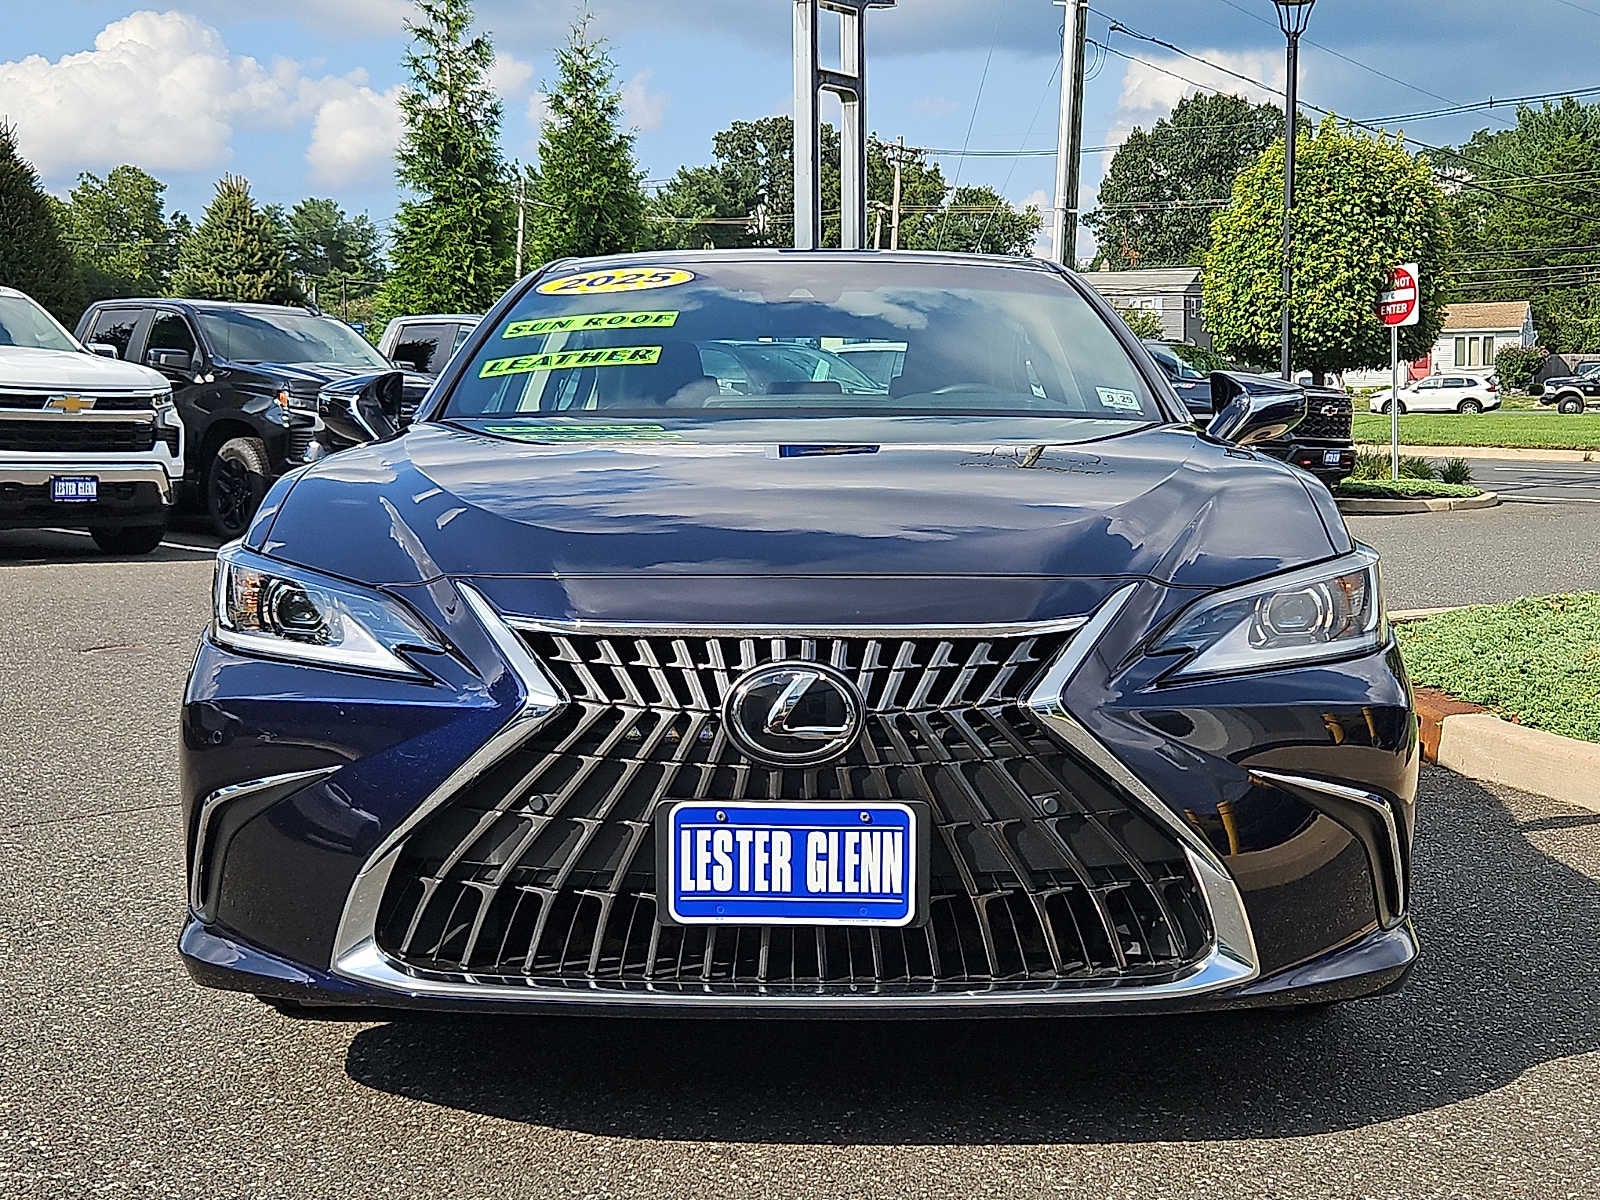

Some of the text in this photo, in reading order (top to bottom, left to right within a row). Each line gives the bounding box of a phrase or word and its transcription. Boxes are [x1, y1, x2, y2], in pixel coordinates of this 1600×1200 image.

[553, 271, 676, 292] 2025
[1381, 303, 1407, 316] ENTER
[508, 314, 675, 335] SUN ROOF
[486, 348, 654, 373] LEATHER
[55, 481, 77, 496] LESTER
[680, 829, 903, 894] LESTER GLENN
